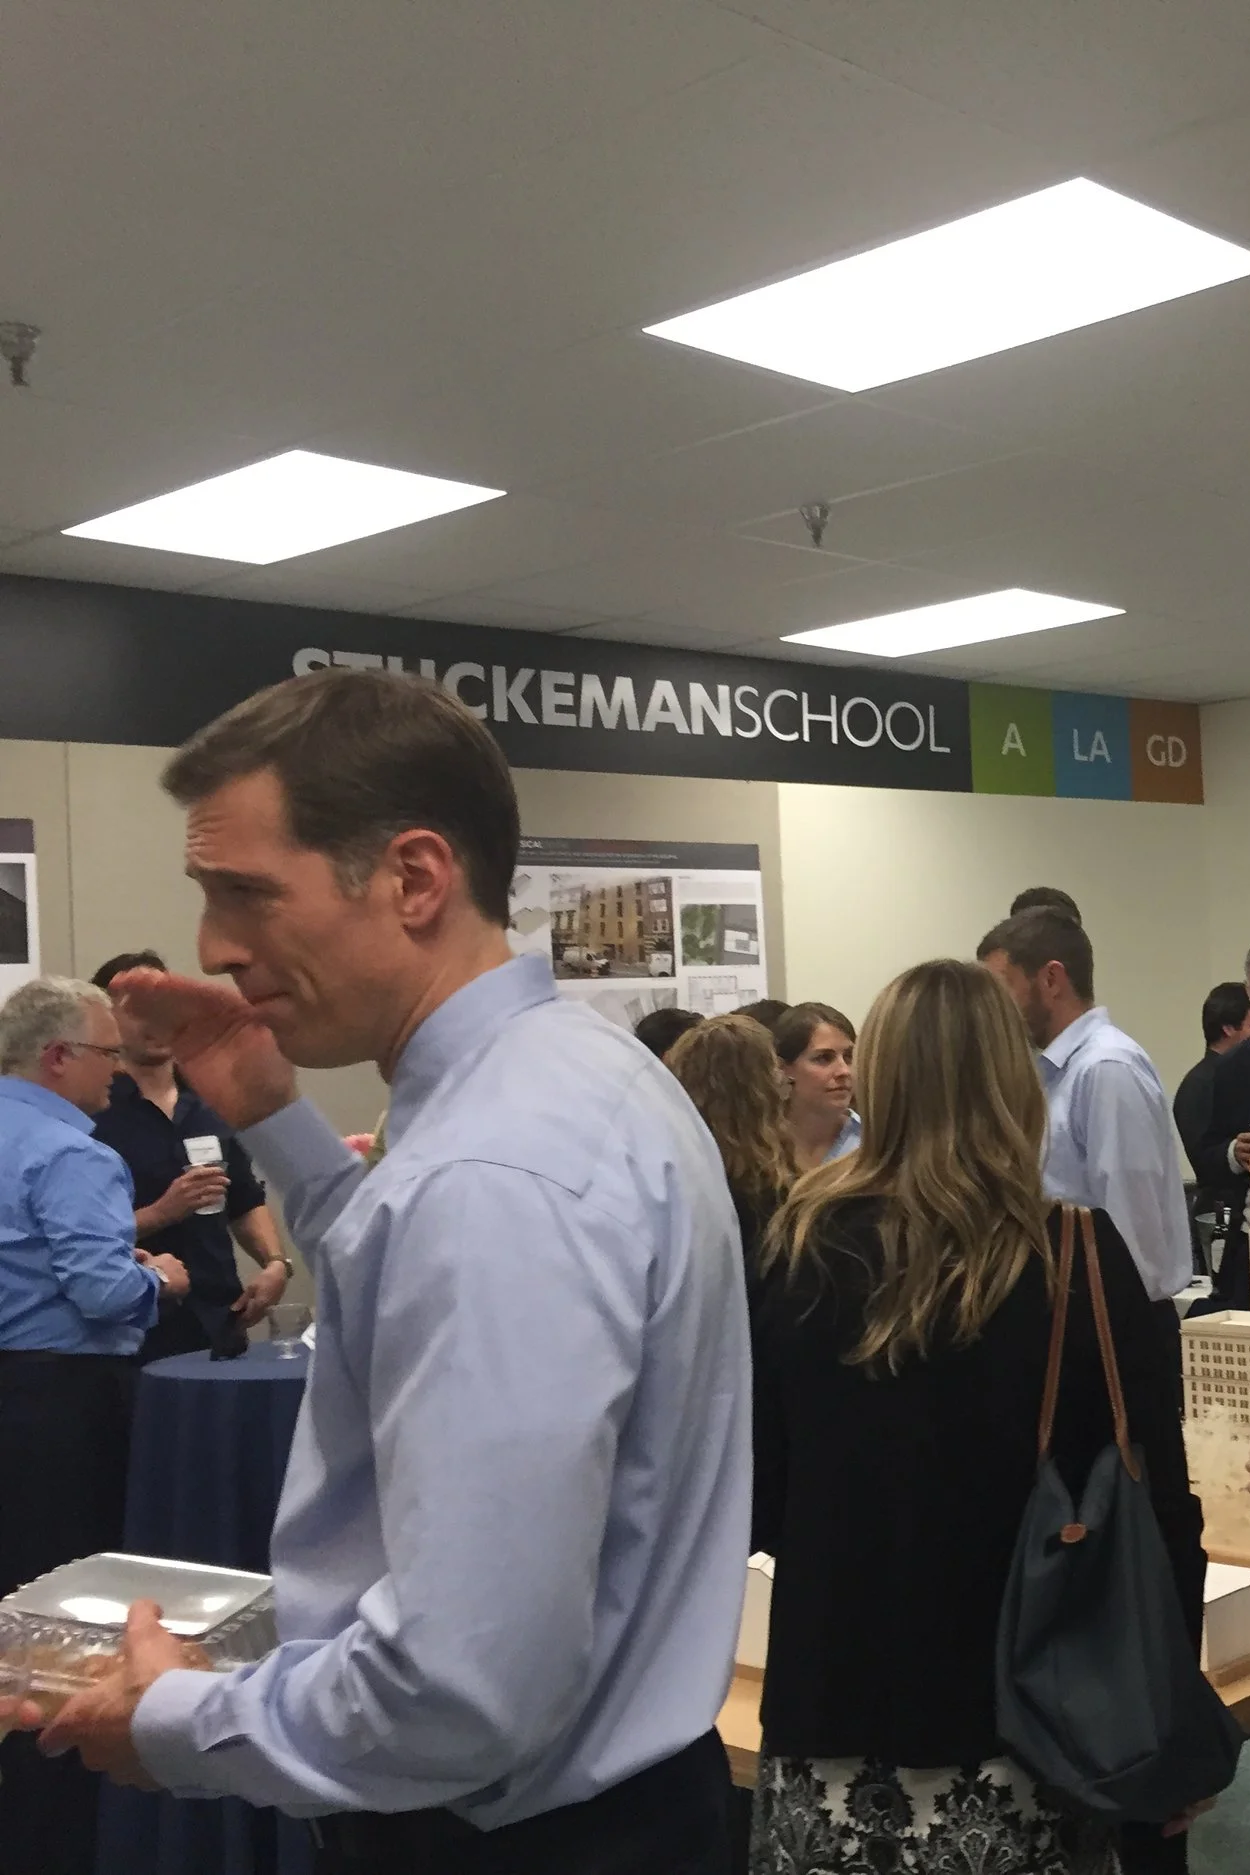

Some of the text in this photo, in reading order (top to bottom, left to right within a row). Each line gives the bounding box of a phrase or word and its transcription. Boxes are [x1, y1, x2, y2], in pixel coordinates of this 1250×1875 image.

[1002, 723, 1027, 757] A
[1073, 729, 1112, 763] LA
[1147, 735, 1187, 767] GD
